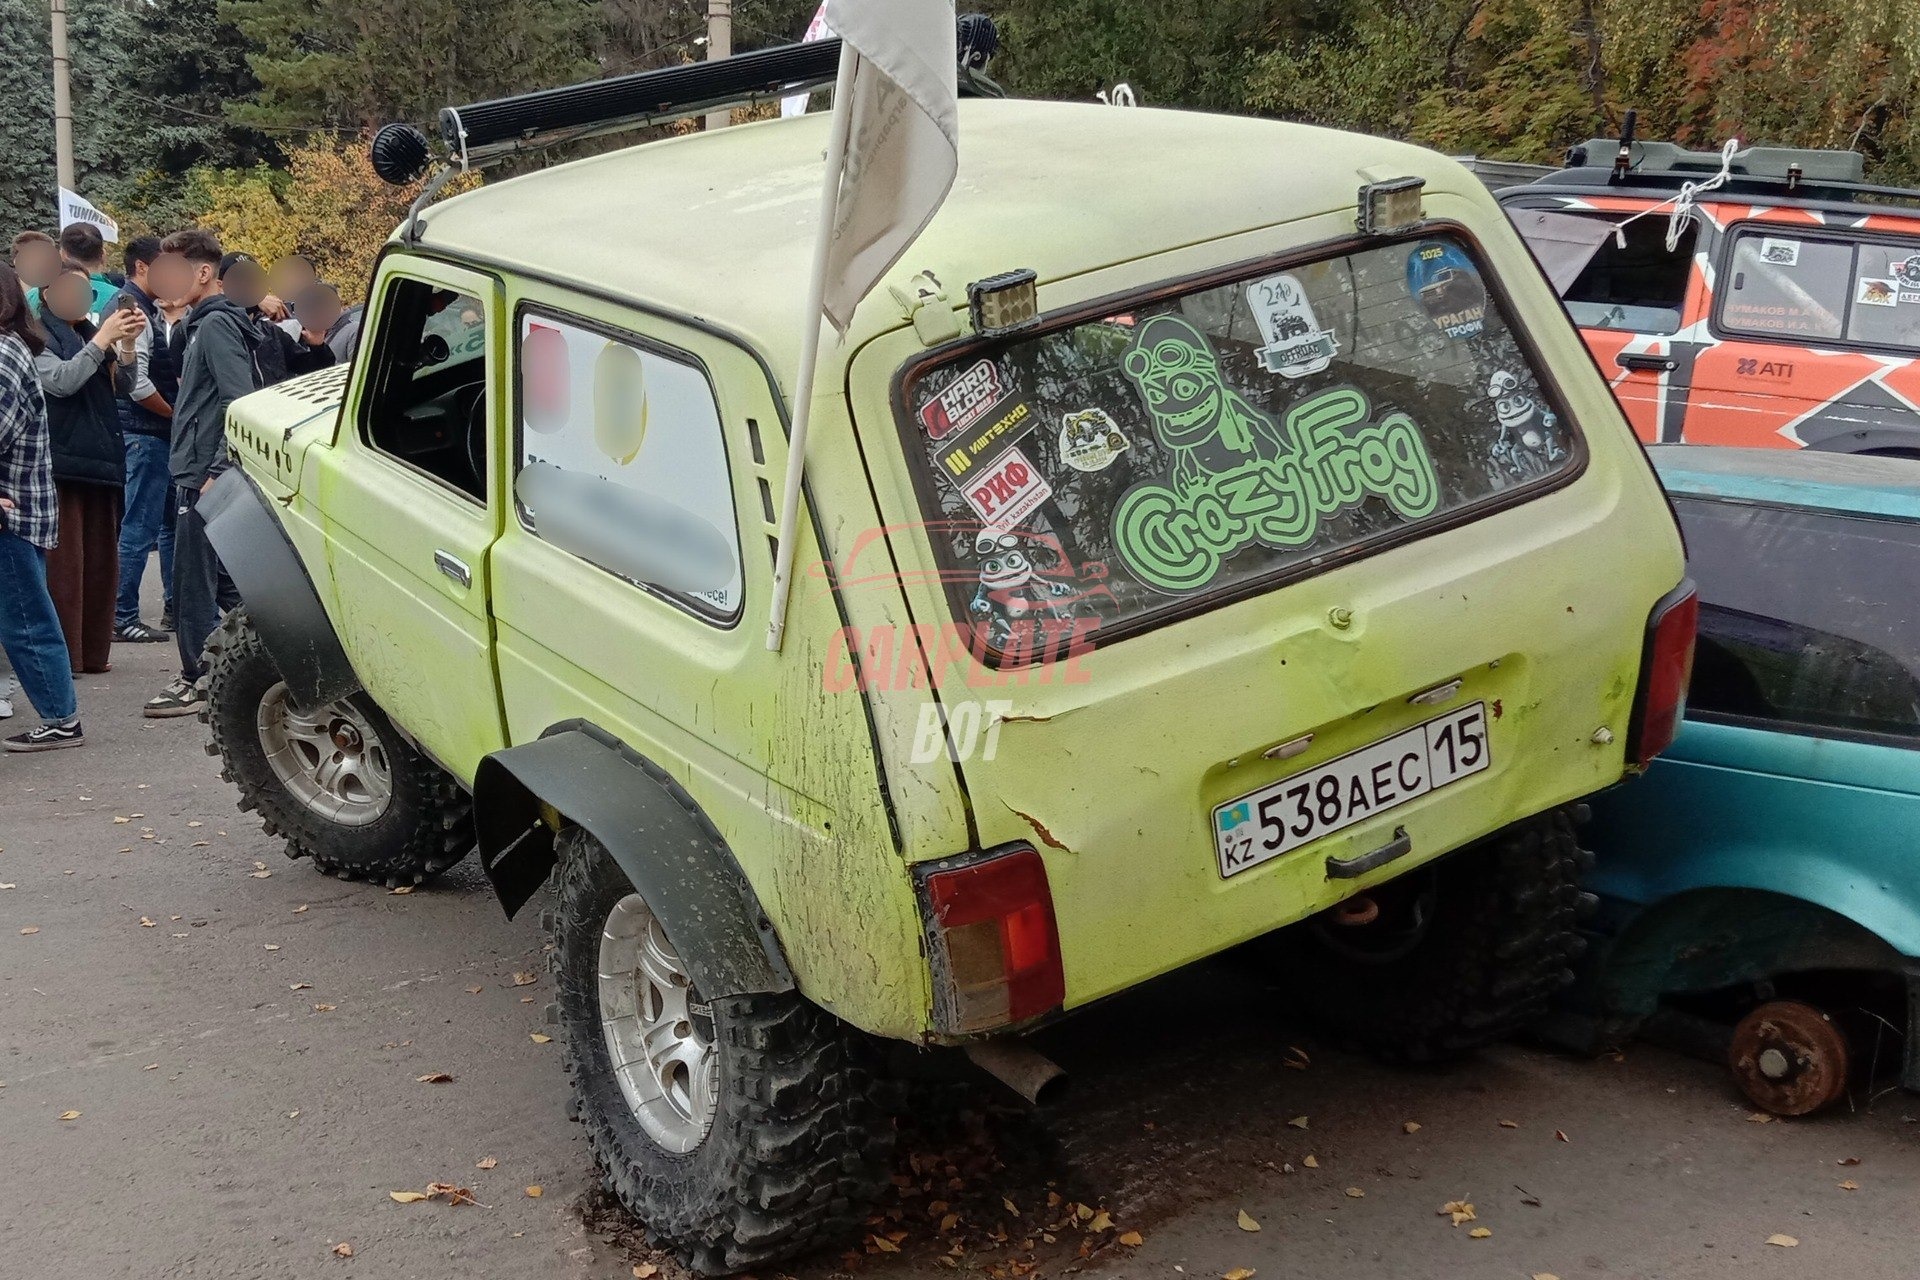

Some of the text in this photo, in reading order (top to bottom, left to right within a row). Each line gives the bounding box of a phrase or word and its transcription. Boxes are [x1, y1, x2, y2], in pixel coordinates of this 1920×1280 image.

[1420, 248, 1444, 260] 2025
[1433, 307, 1484, 329] УРАГАН
[1445, 320, 1483, 338] ТРОФИ
[1759, 362, 1793, 378] ATI
[940, 363, 991, 412] HARD
[946, 377, 996, 424] BLOCK
[971, 461, 1029, 517] РИФ
[1224, 713, 1482, 868] KZ 538AEC 15
